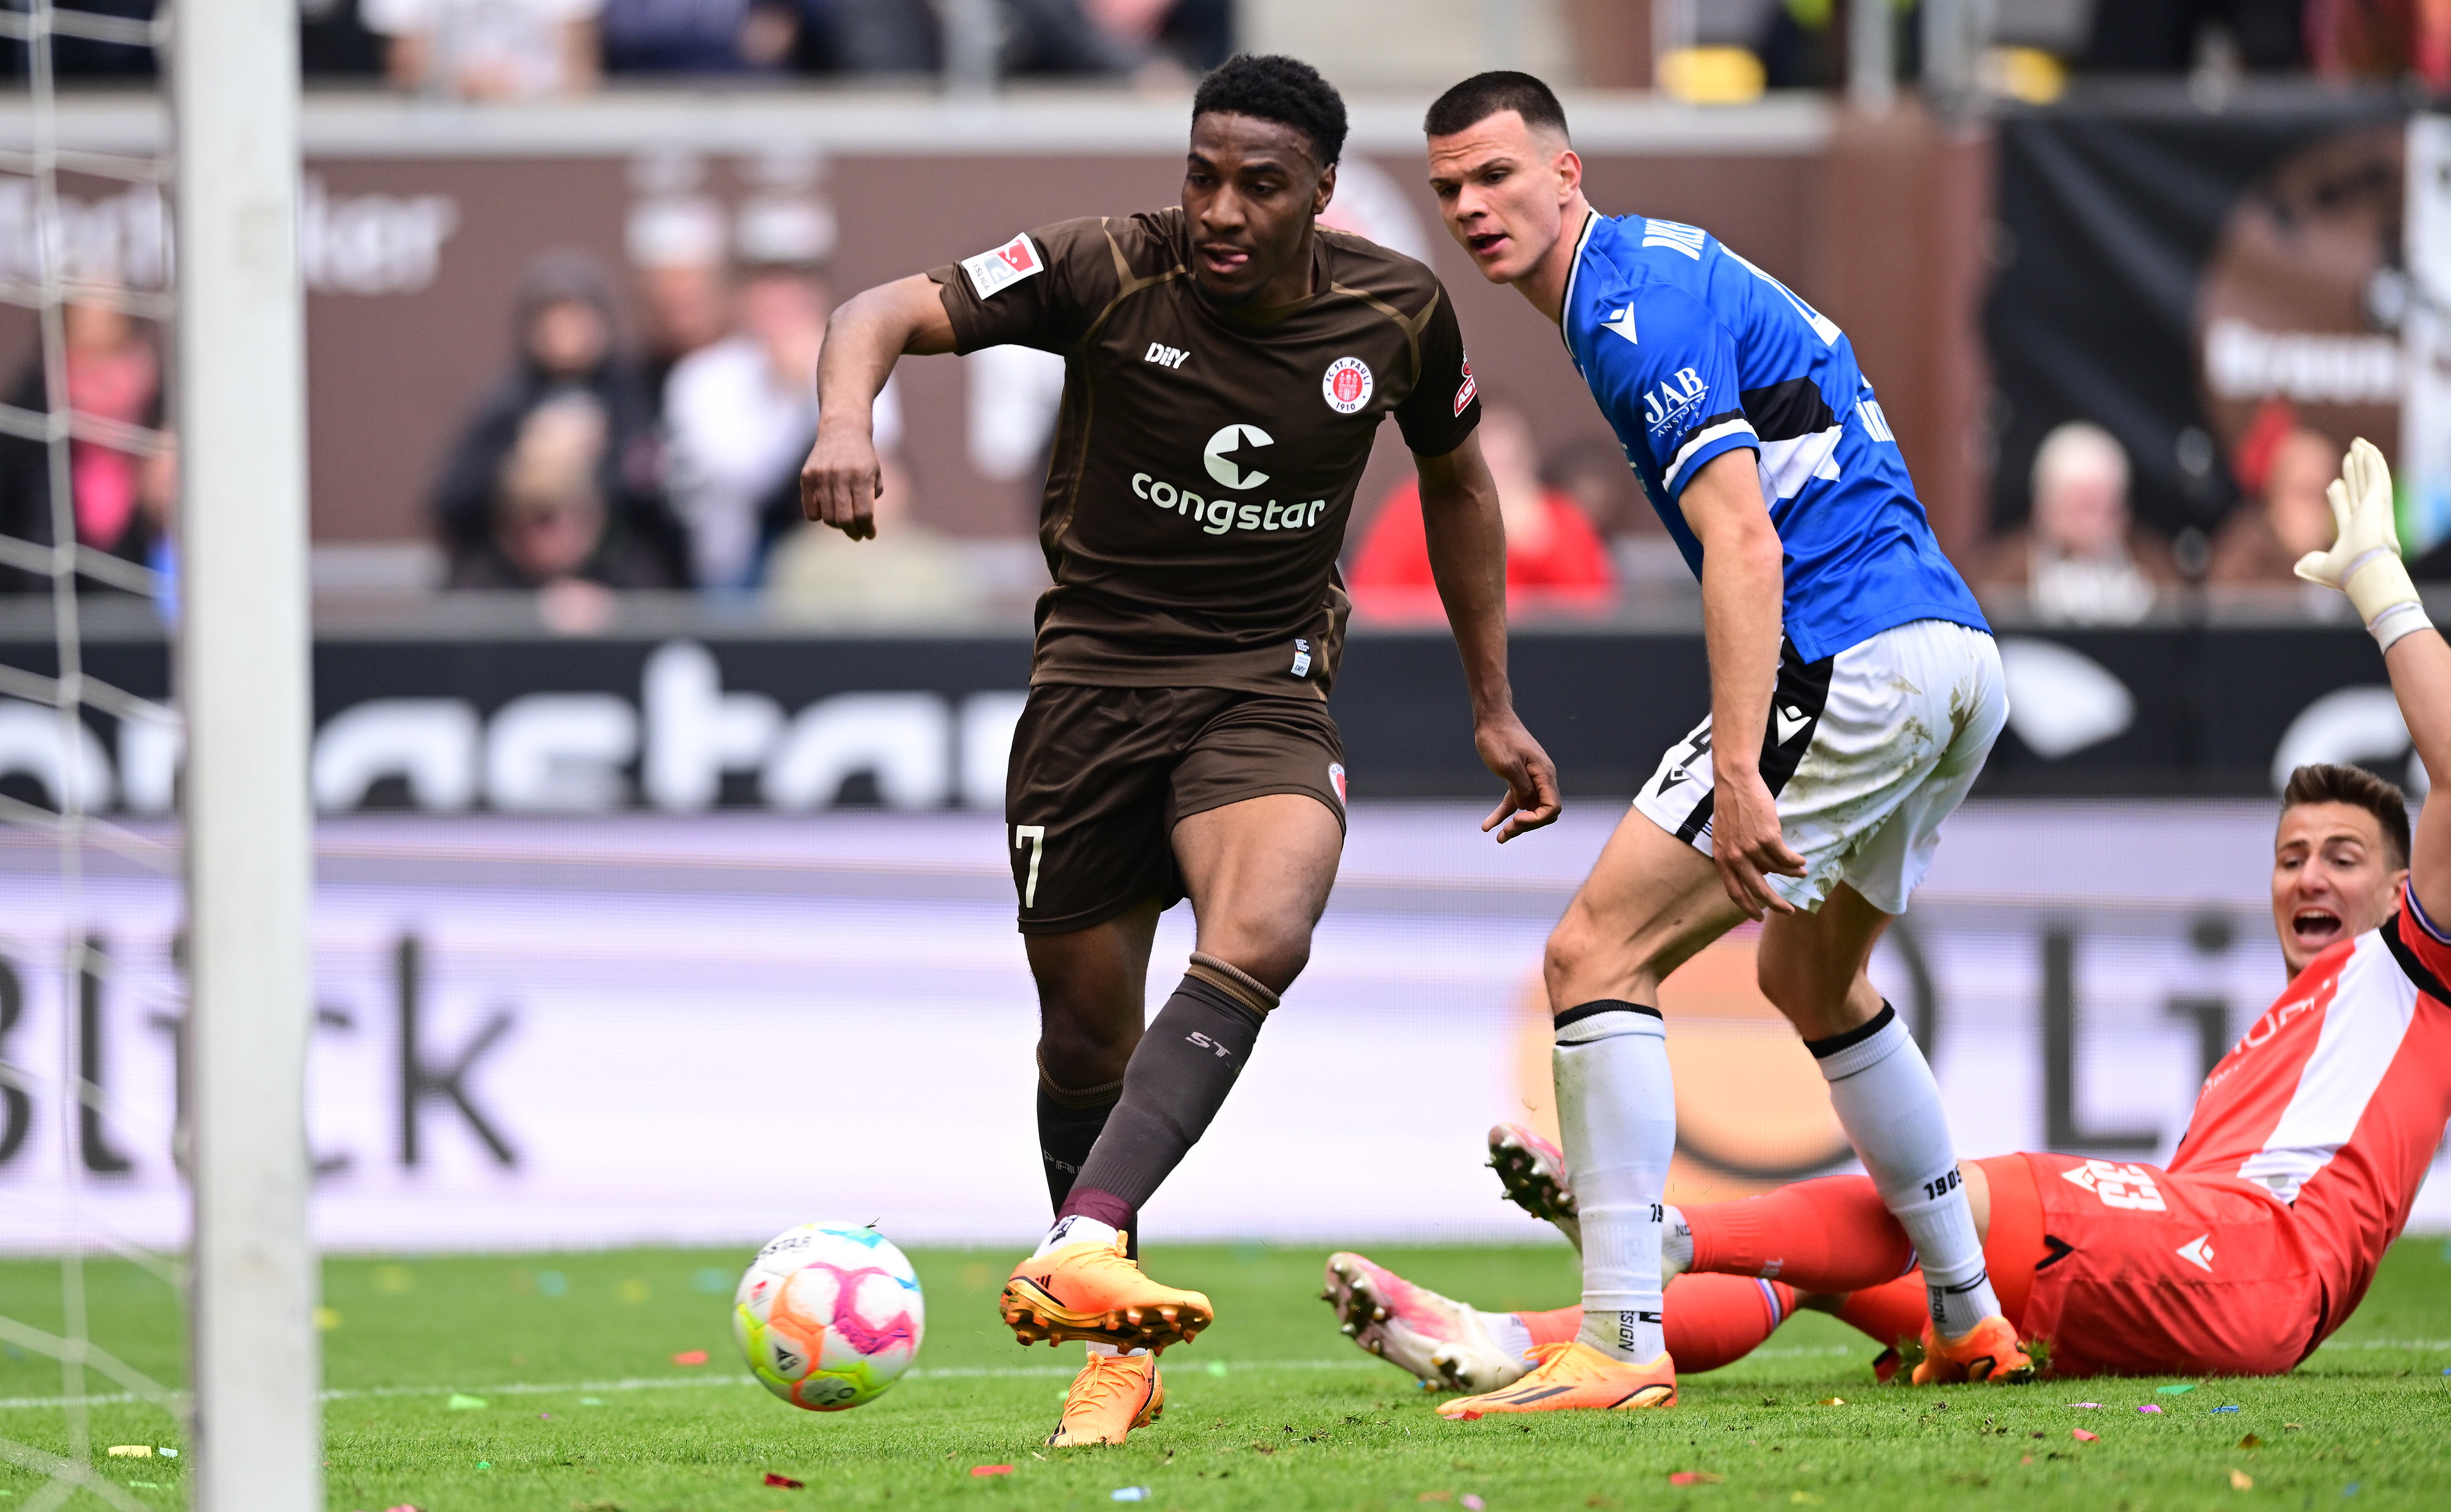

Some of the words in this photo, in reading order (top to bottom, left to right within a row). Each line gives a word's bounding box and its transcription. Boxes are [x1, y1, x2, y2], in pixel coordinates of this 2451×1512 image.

[1326, 371, 1334, 382] FC
[1350, 359, 1371, 385] PAULI
[1643, 367, 1704, 423] JAB
[1336, 402, 1355, 411] 1910
[1132, 472, 1325, 535] congstar
[1006, 822, 1045, 908] 7
